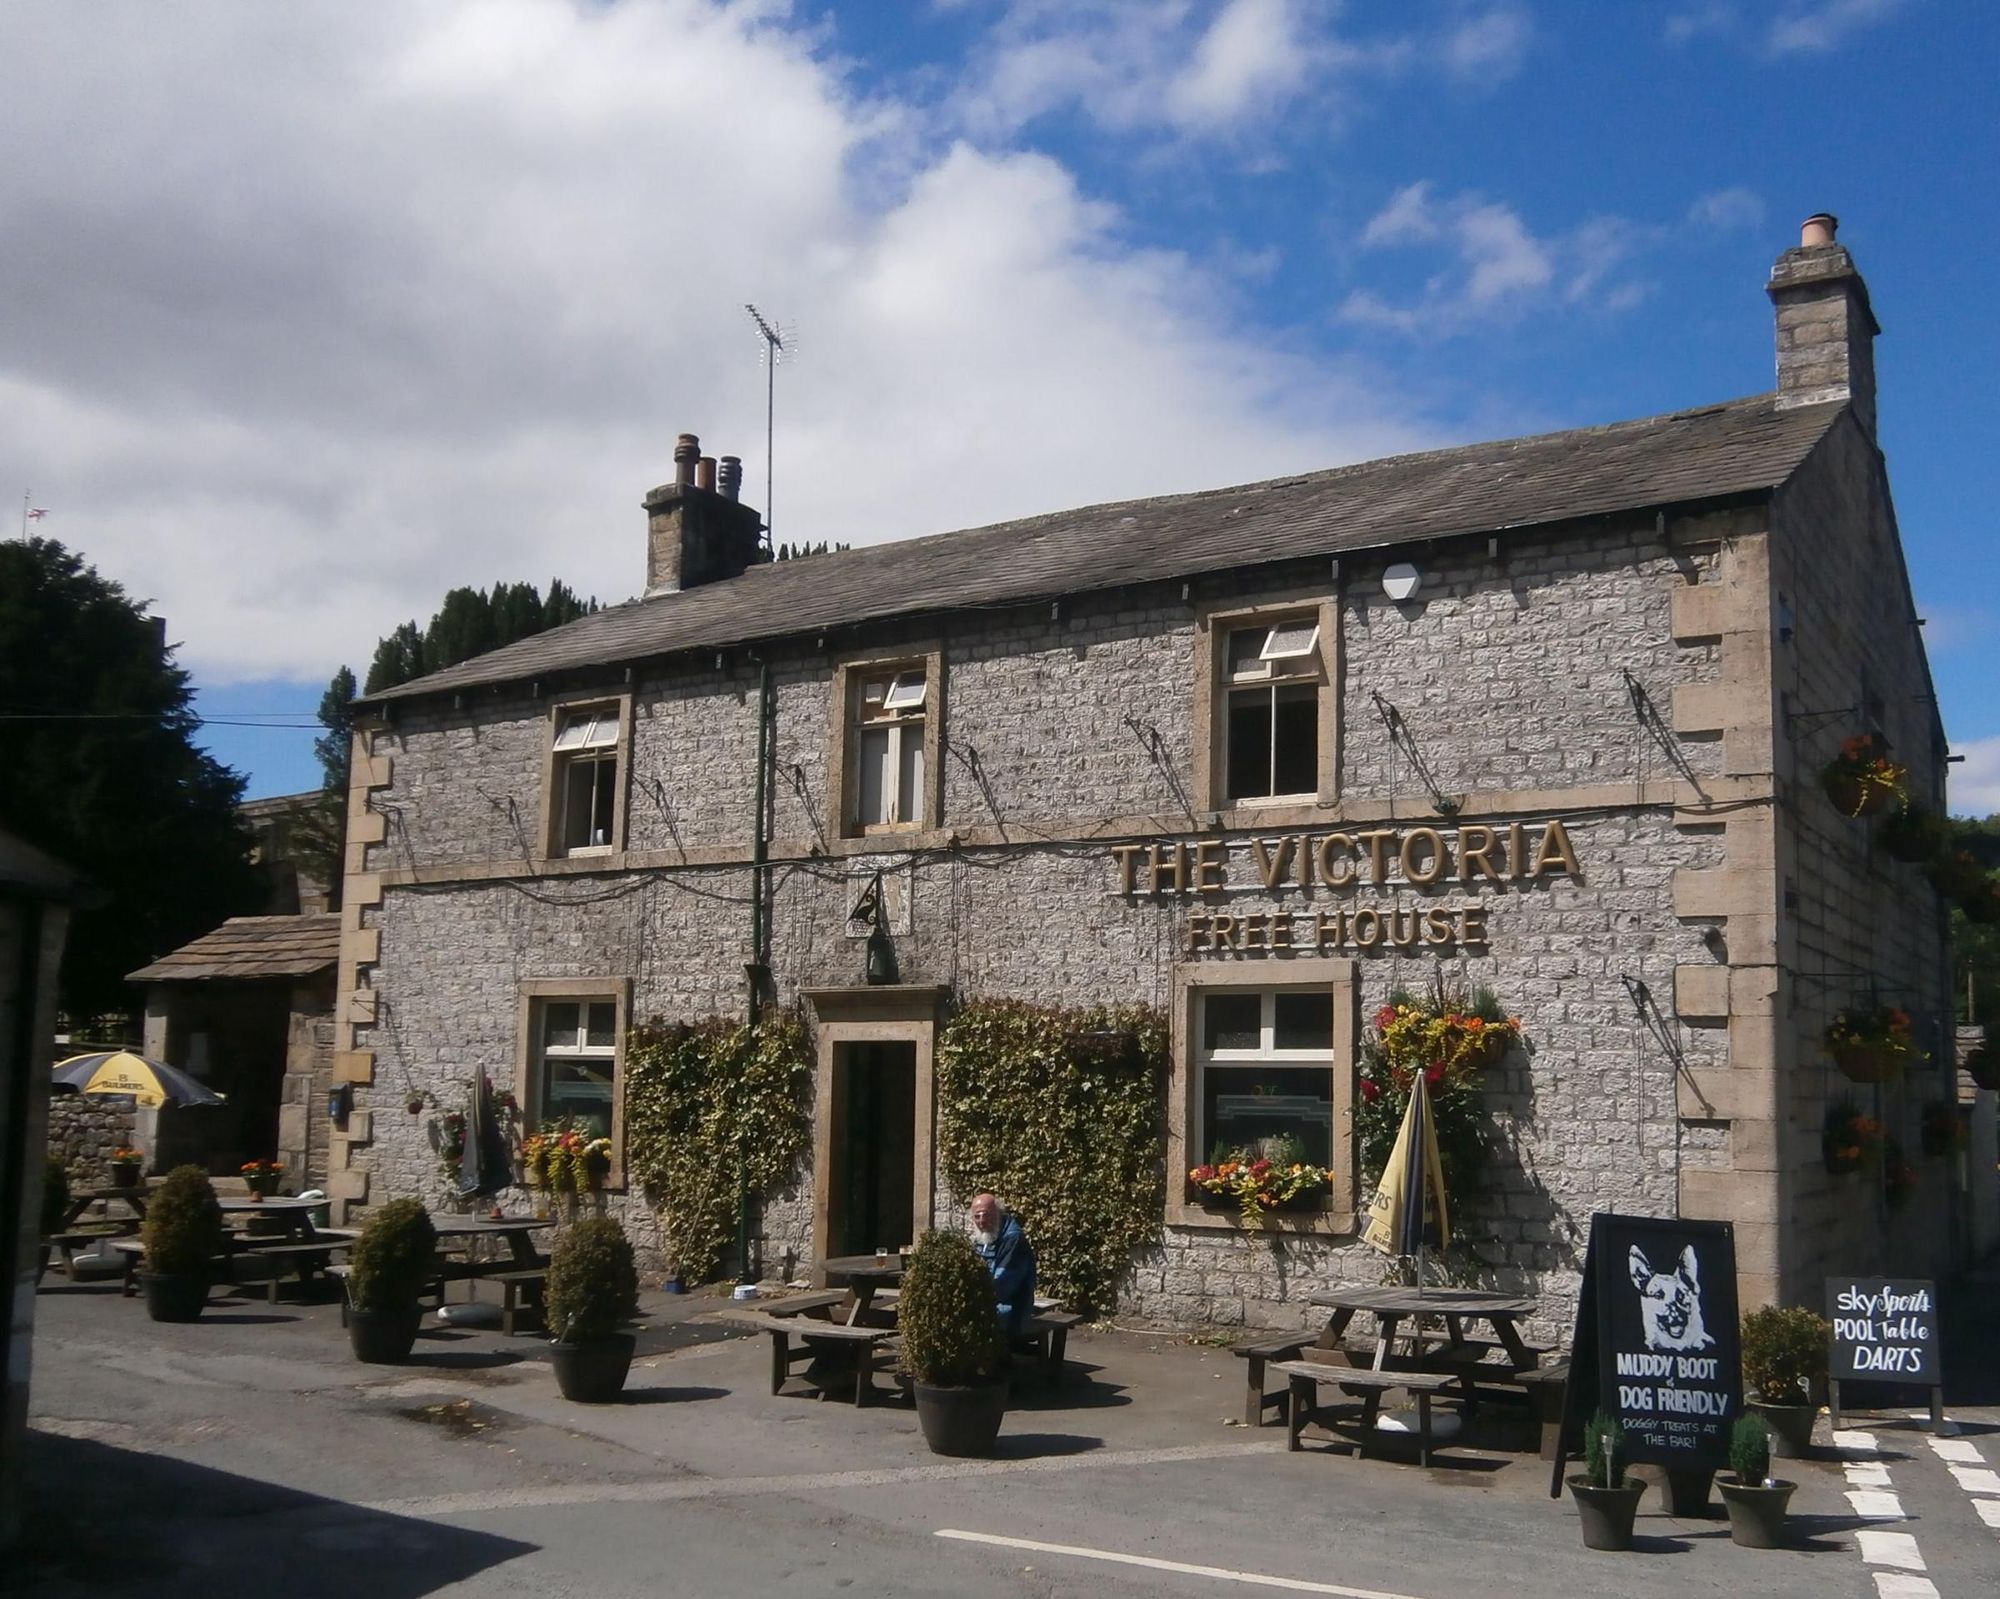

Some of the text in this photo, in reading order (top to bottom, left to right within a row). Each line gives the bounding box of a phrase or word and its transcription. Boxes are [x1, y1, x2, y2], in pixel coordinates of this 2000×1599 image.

[1111, 820, 1582, 895] THE VICTORIA
[1186, 906, 1489, 952] FREE HOUSE
[1876, 1285, 1931, 1318] Sports
[1834, 1317, 1930, 1341] POOL Table
[1617, 1353, 1718, 1380] MUDDY BOOT
[1853, 1346, 1922, 1373] DARTS
[1619, 1385, 1728, 1416] DOG FRIENDLY
[1622, 1418, 1718, 1434] DOGGY TREATS AT
[1643, 1433, 1696, 1449] THE BAR!
